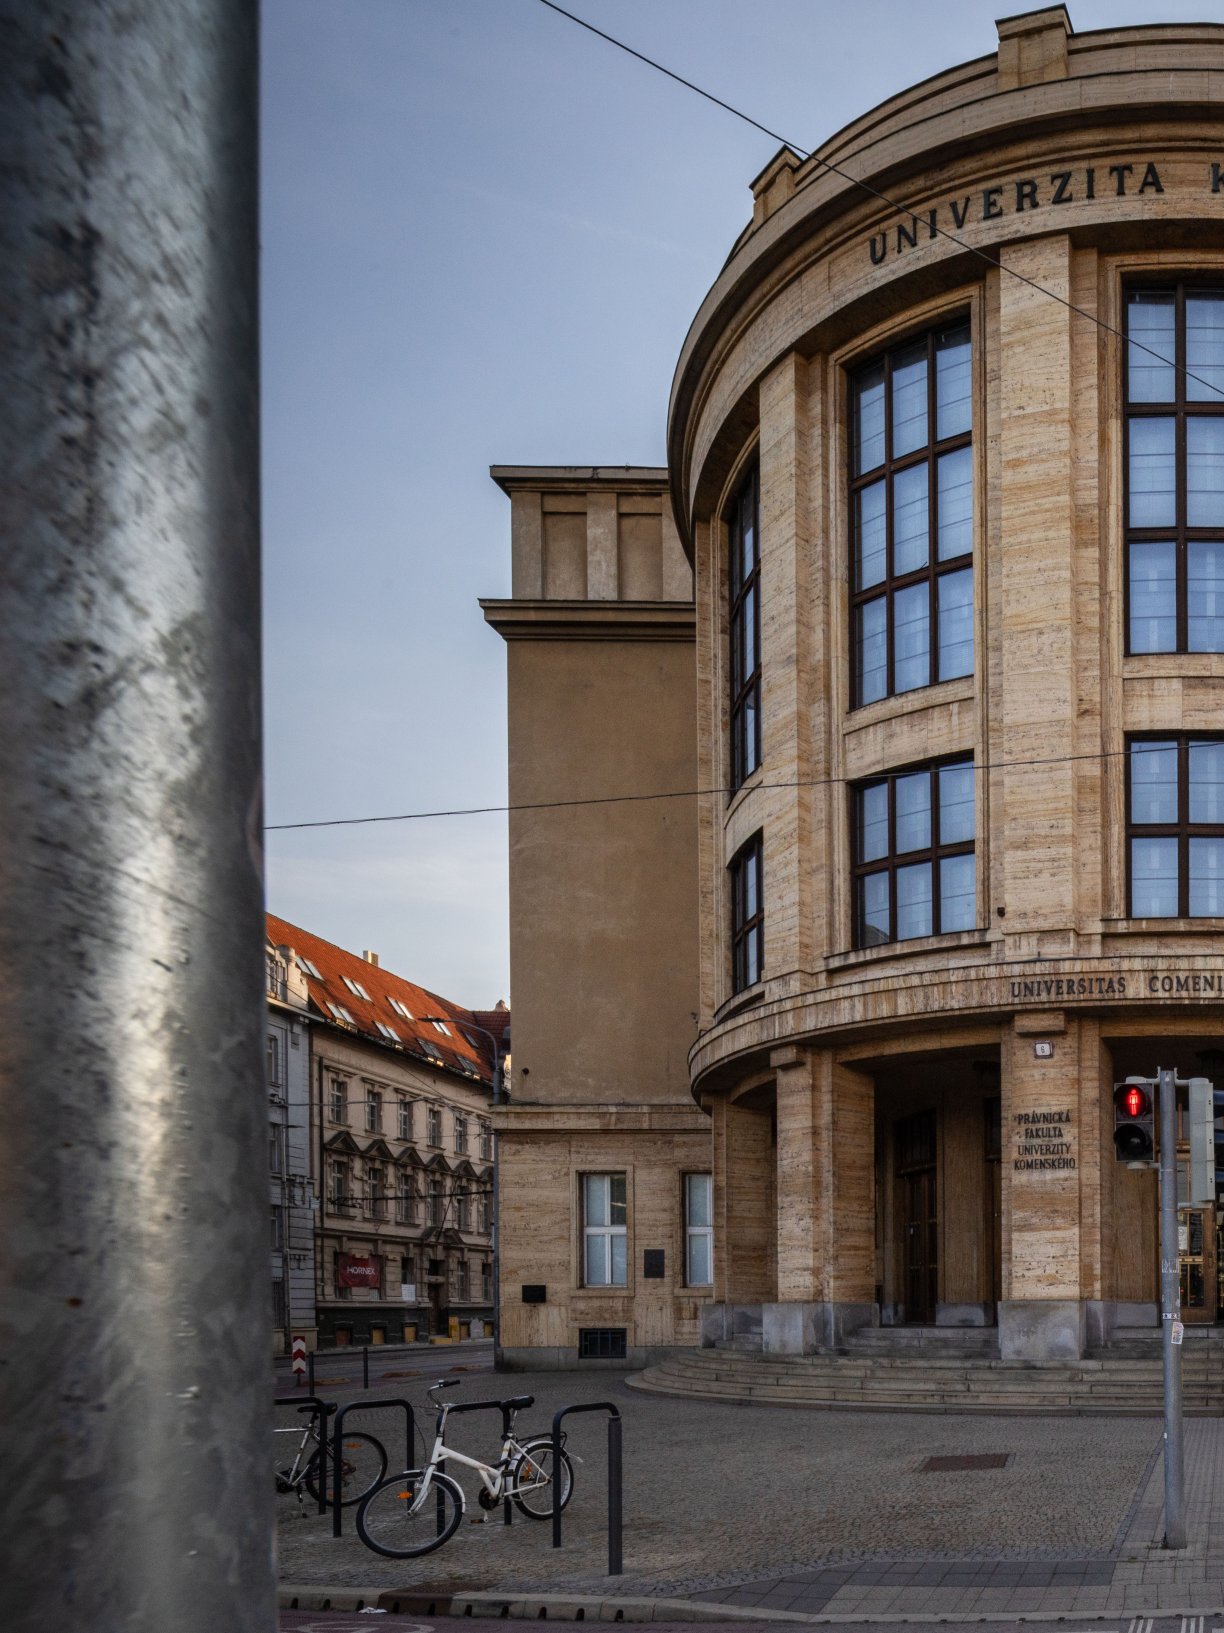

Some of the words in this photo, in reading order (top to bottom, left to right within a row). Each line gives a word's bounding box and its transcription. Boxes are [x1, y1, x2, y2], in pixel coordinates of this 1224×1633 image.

[868, 161, 1165, 265] UNIVERZITA
[1010, 976, 1127, 998] UNIVERSITAS
[1017, 1109, 1071, 1125] PRÁVNICKÁ
[1024, 1126, 1064, 1139] FAKULTA
[1017, 1143, 1072, 1156] UNIVERZITY
[1014, 1156, 1077, 1171] KOMENSKÉHO
